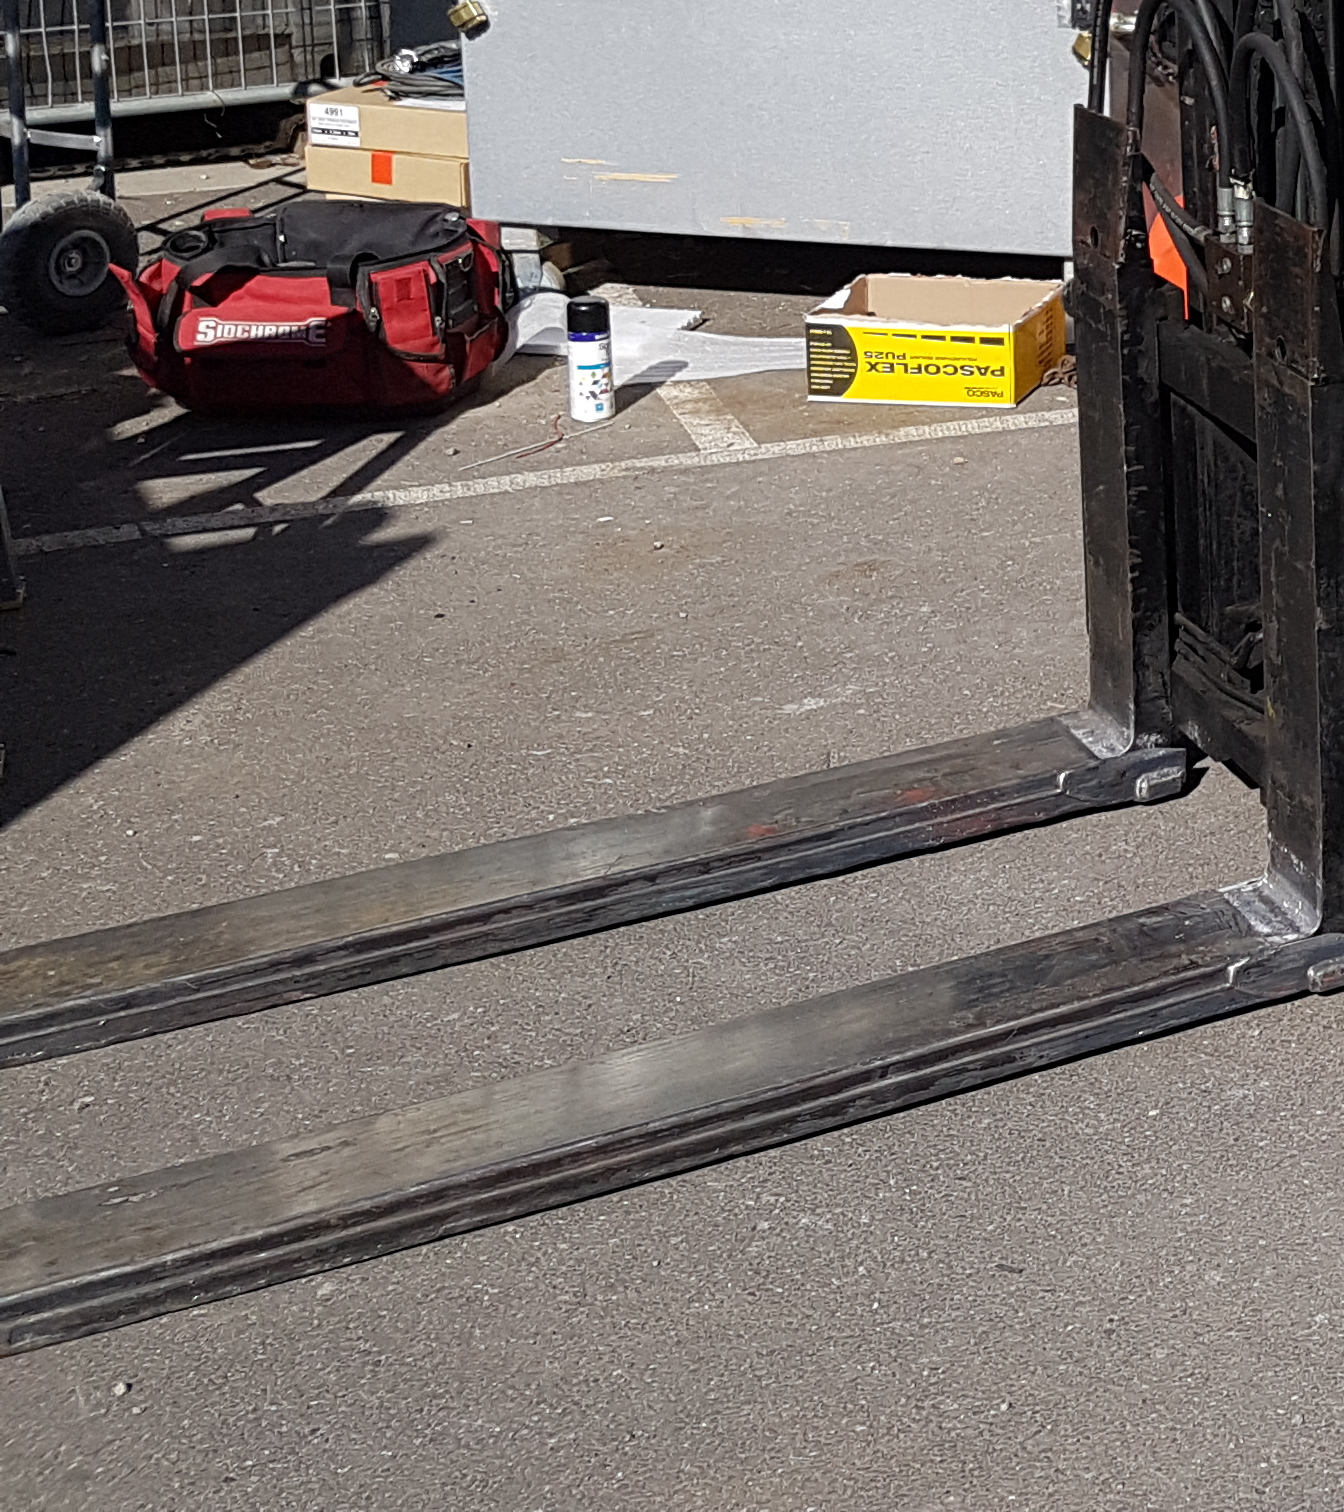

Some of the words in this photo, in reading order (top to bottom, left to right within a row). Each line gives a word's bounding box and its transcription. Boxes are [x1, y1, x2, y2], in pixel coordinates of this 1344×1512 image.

[196, 320, 326, 343] SIDCHROME
[863, 351, 907, 361] PU25
[866, 360, 1005, 377] PASCOFLEX
[966, 389, 1004, 398] PASCO
